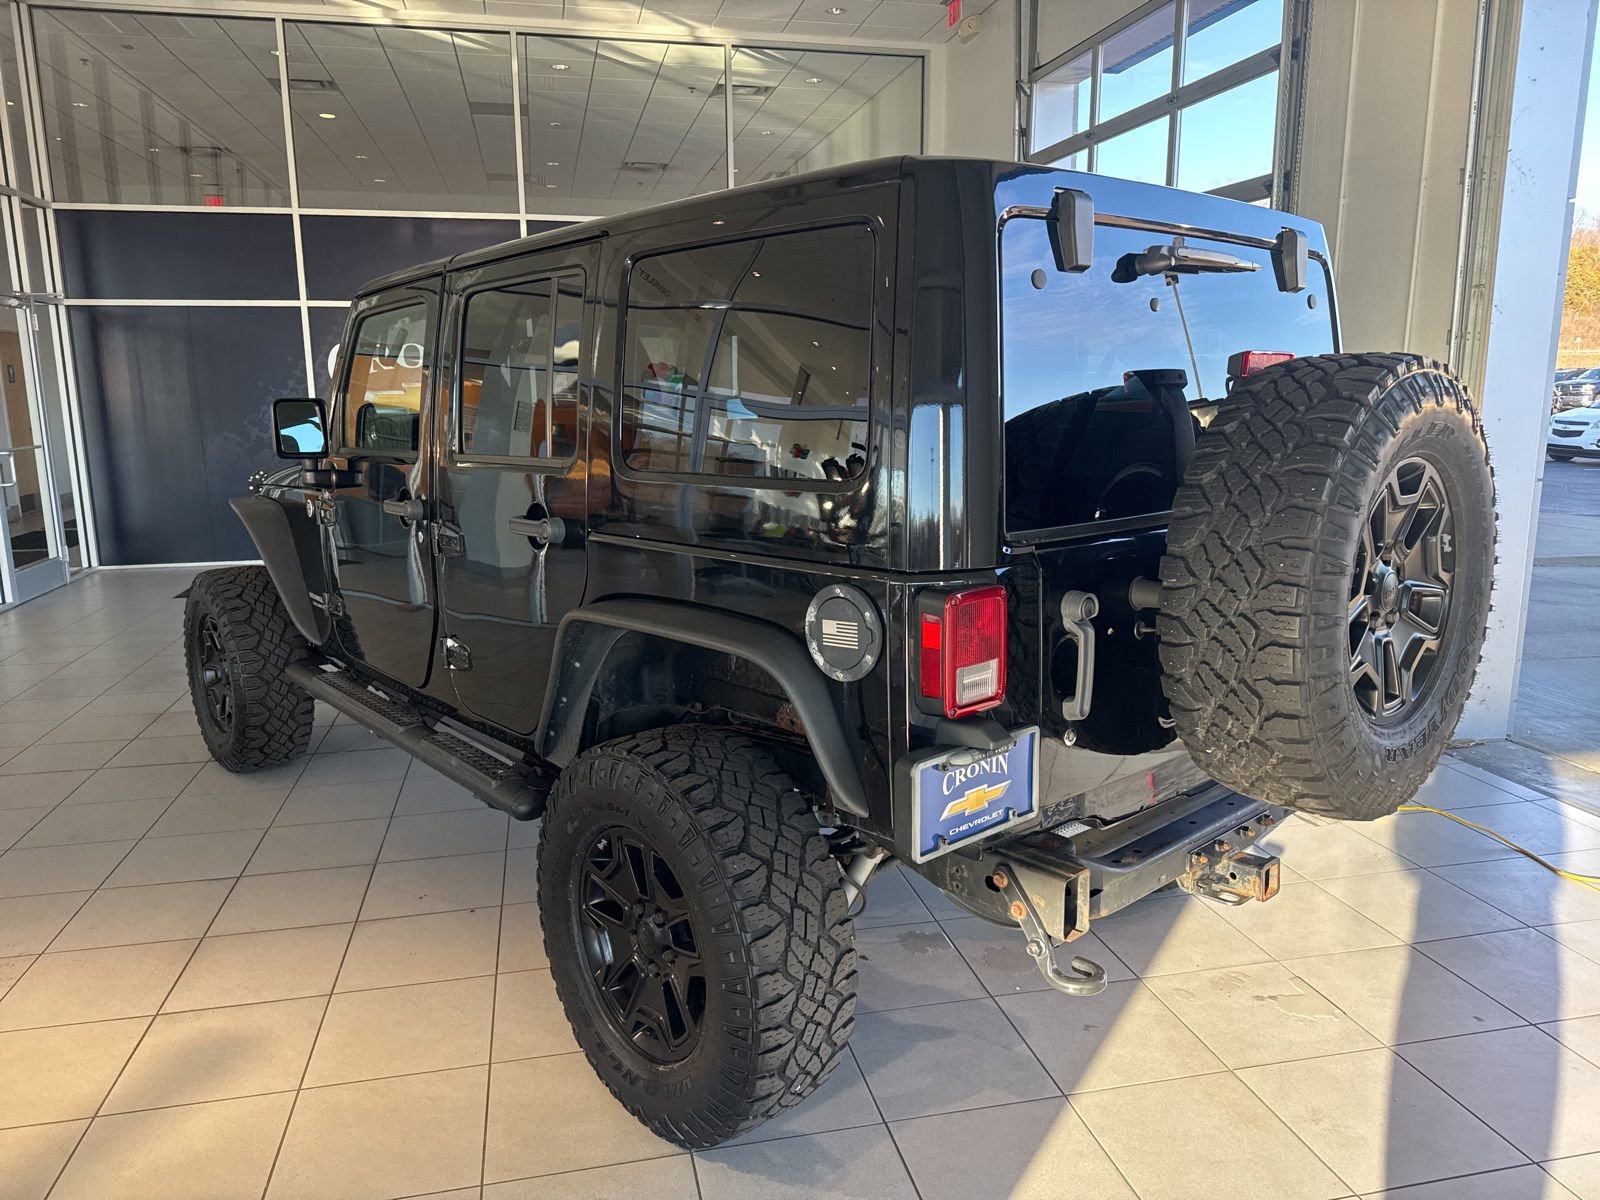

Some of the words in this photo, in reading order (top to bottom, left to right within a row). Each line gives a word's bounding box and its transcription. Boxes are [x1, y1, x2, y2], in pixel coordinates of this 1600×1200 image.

[1384, 582, 1484, 763] GOODYEAR
[942, 752, 1009, 796] CRONIN
[949, 808, 1005, 836] CHEVROLET
